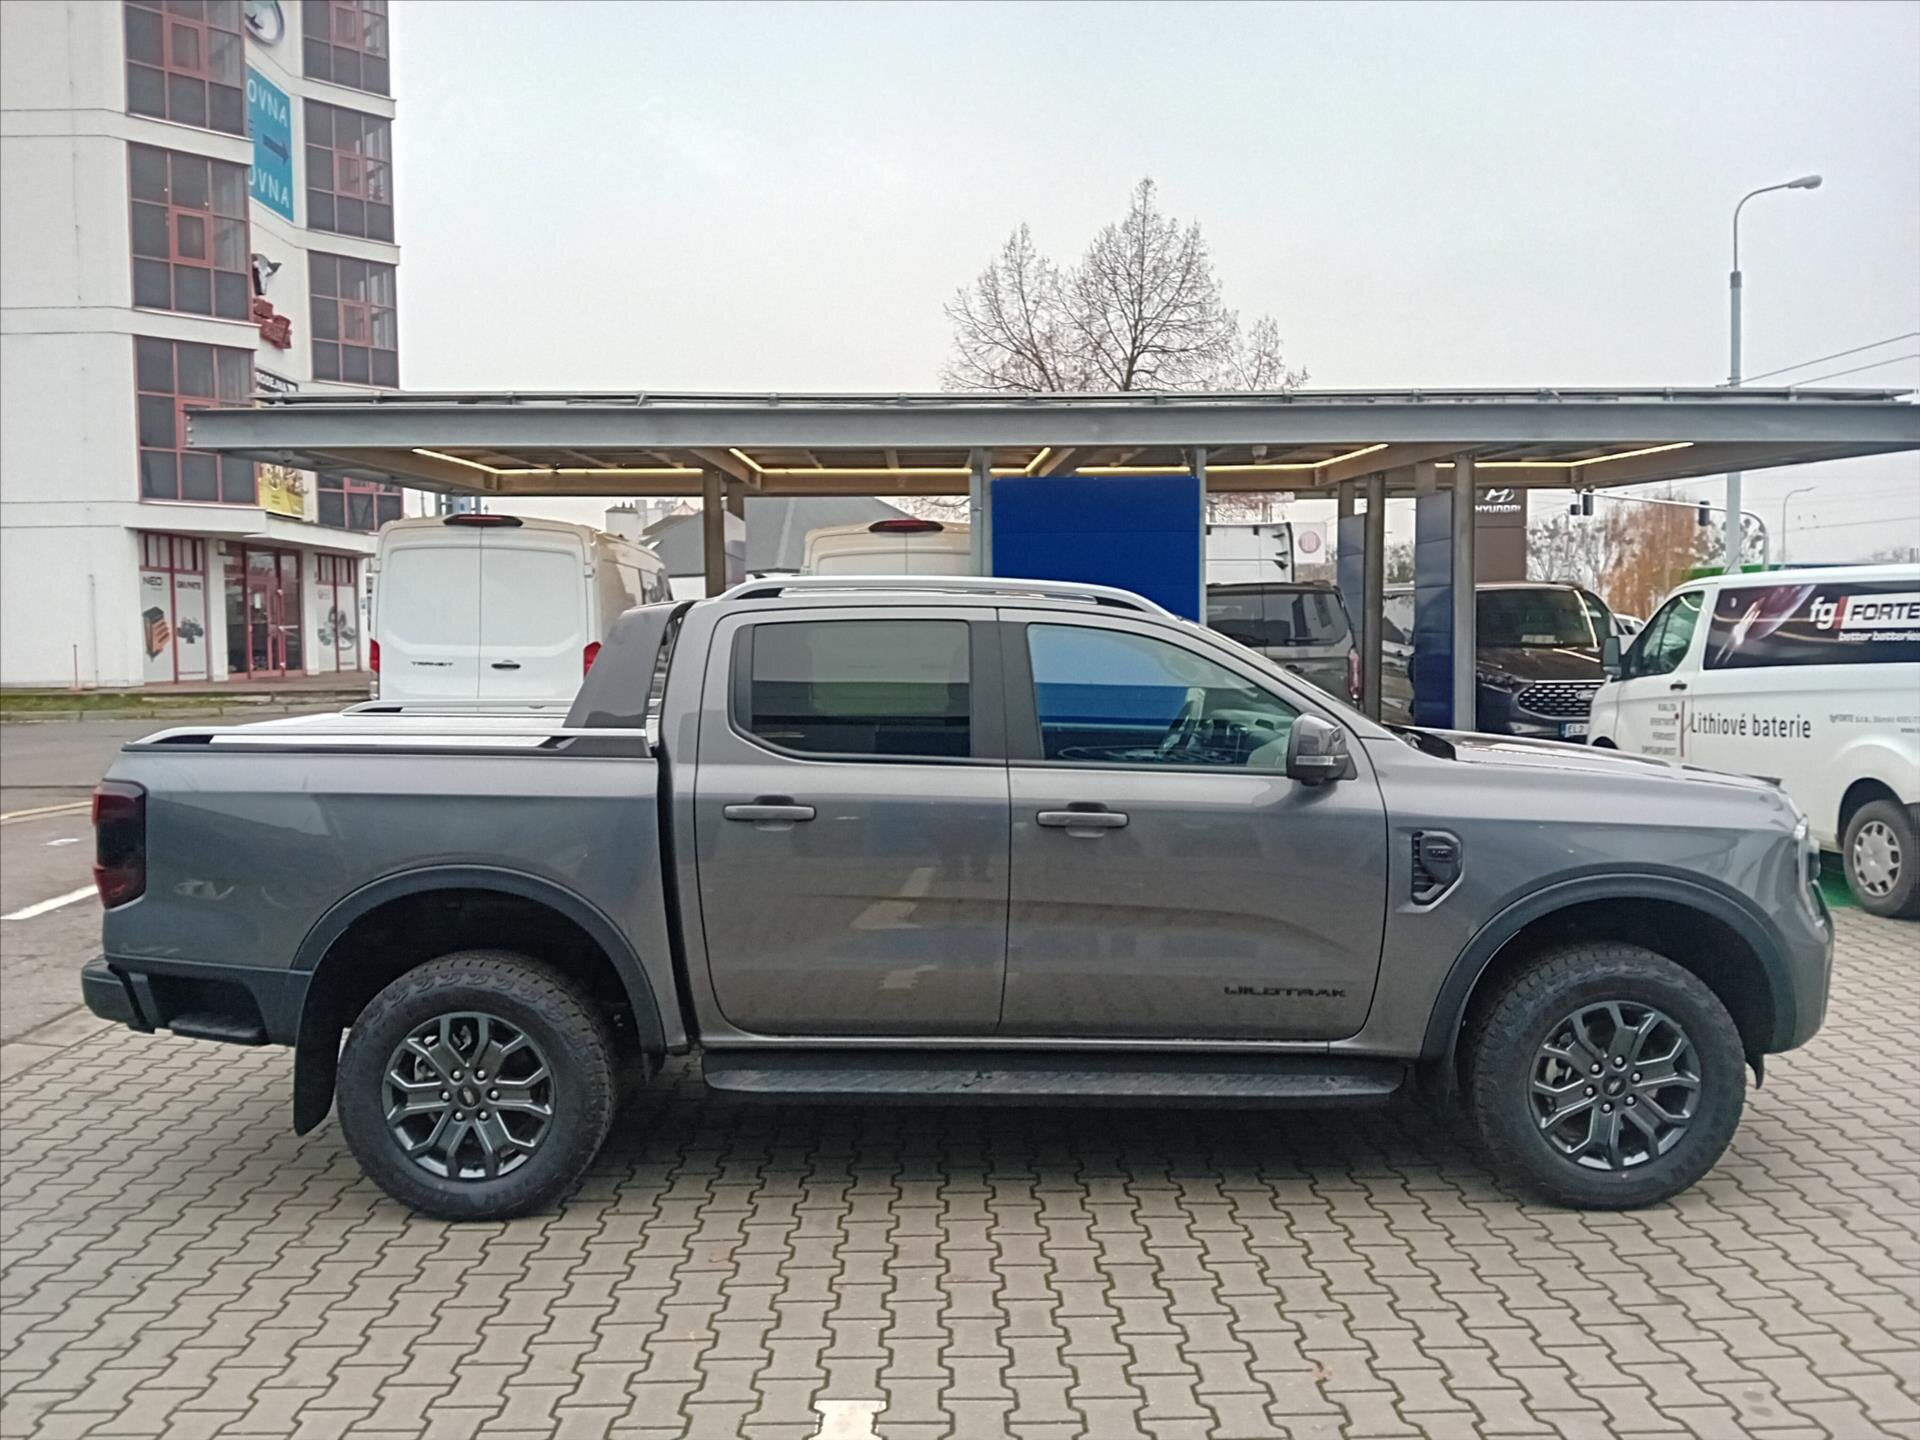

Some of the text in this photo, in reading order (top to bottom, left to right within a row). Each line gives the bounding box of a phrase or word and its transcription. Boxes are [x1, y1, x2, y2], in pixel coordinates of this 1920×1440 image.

[1474, 504, 1522, 513] HYUNDAI
[1809, 596, 1920, 630] fg FORTE
[1691, 711, 1812, 739] Lithiové baterie
[1224, 985, 1347, 998] WILDTRAK
